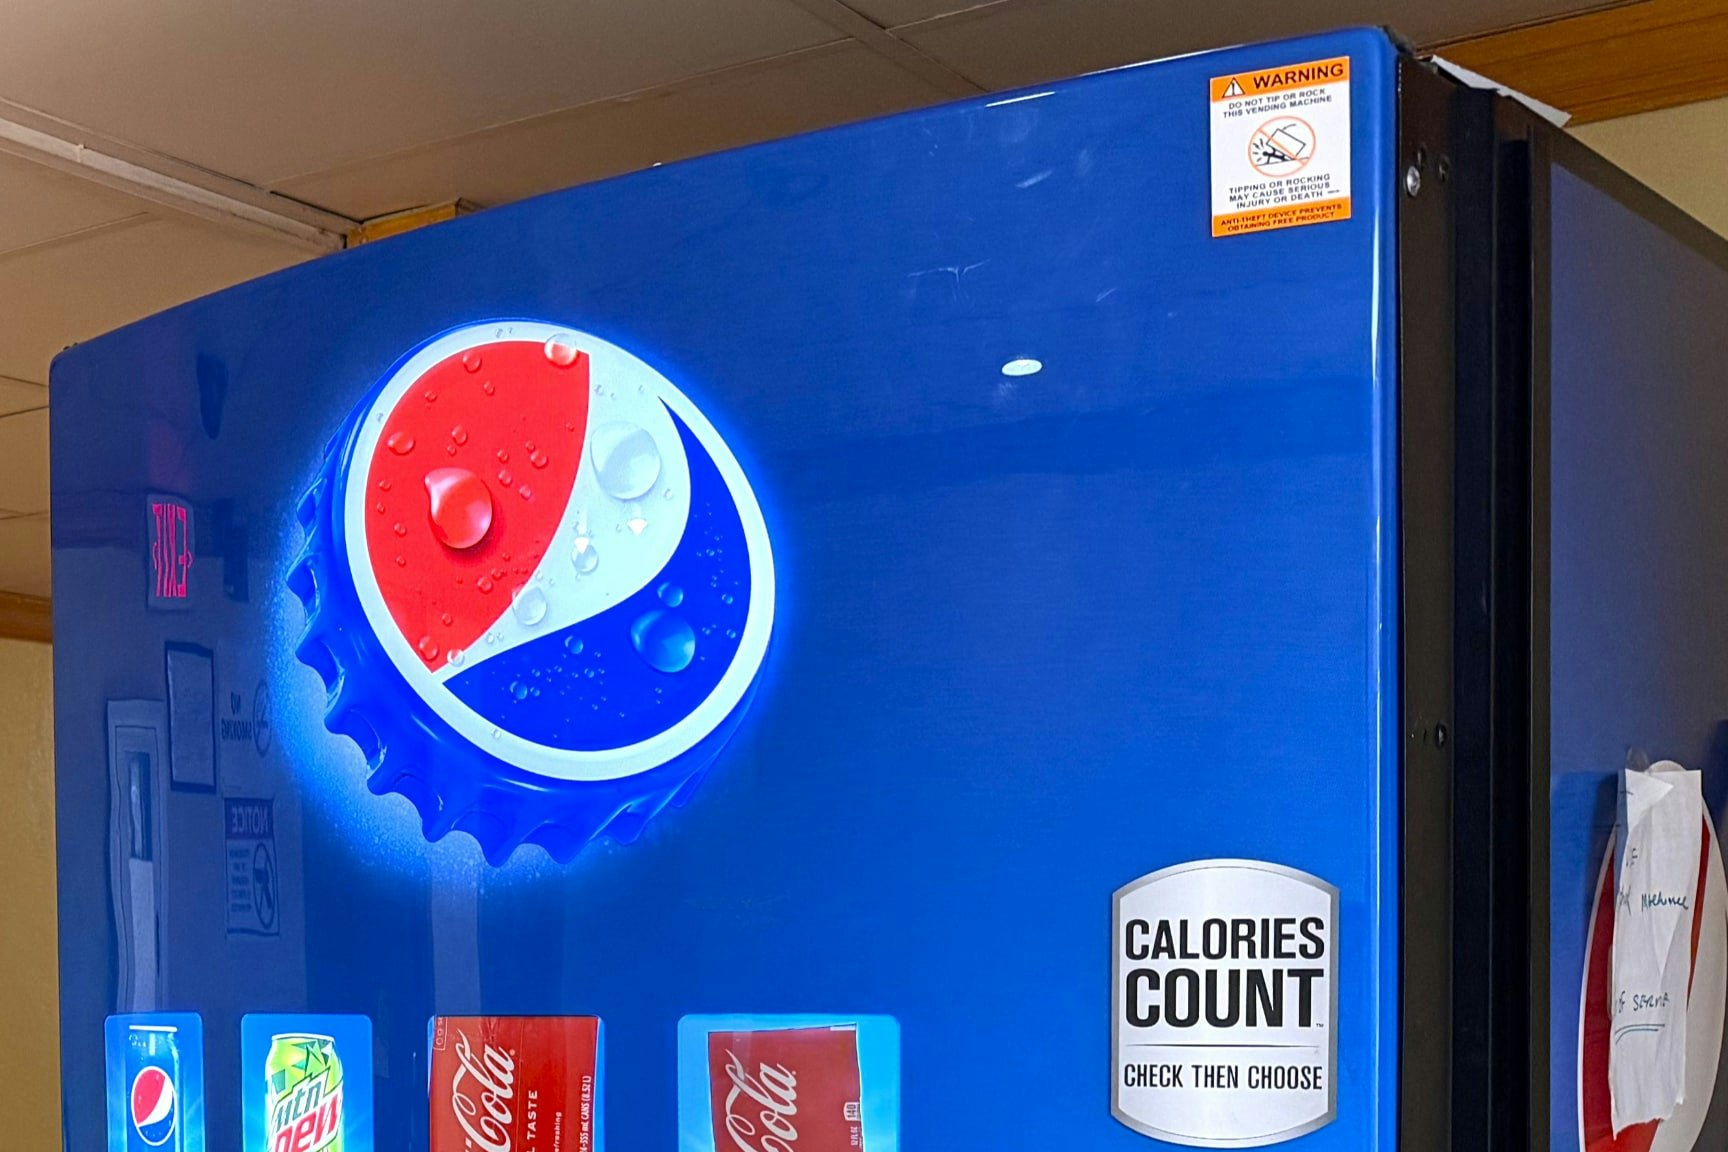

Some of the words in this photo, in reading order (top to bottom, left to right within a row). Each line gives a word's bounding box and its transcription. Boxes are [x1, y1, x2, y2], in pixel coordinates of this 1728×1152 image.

[1253, 63, 1344, 89] WARNING
[1223, 109, 1243, 119] THIS
[1245, 102, 1287, 115] VENDING
[1289, 95, 1332, 108] MACHINE
[1228, 100, 1243, 110] DO
[1244, 97, 1263, 107] NOT
[1266, 94, 1281, 104] TIP
[1283, 91, 1297, 101] OR
[1299, 88, 1326, 99] ROCK
[1229, 183, 1266, 194] TIPPING
[1269, 180, 1283, 189] OR
[1285, 173, 1330, 186] ROCKING
[1229, 193, 1249, 203] MAY
[1252, 188, 1285, 199] CAUSE
[1288, 181, 1330, 194] SERIOUS
[1236, 198, 1270, 209] INJURY
[1273, 195, 1288, 204] OR
[1290, 191, 1323, 202] DEATH
[1221, 213, 1266, 226] ANTI-THEFT
[1268, 208, 1297, 220] DEVICE
[1299, 203, 1342, 215] PREVENTS
[1228, 219, 1270, 232] OBTAINING
[1273, 216, 1294, 226] FREE
[1296, 211, 1335, 223] PRODUCT
[1125, 917, 1325, 960] CALORIES
[1126, 968, 1325, 1028] COUNT
[1124, 1064, 1183, 1088] CHECK
[1191, 1065, 1239, 1089] THEN
[1247, 1066, 1322, 1090] CHOOSE
[526, 1090, 539, 1141] TASTE
